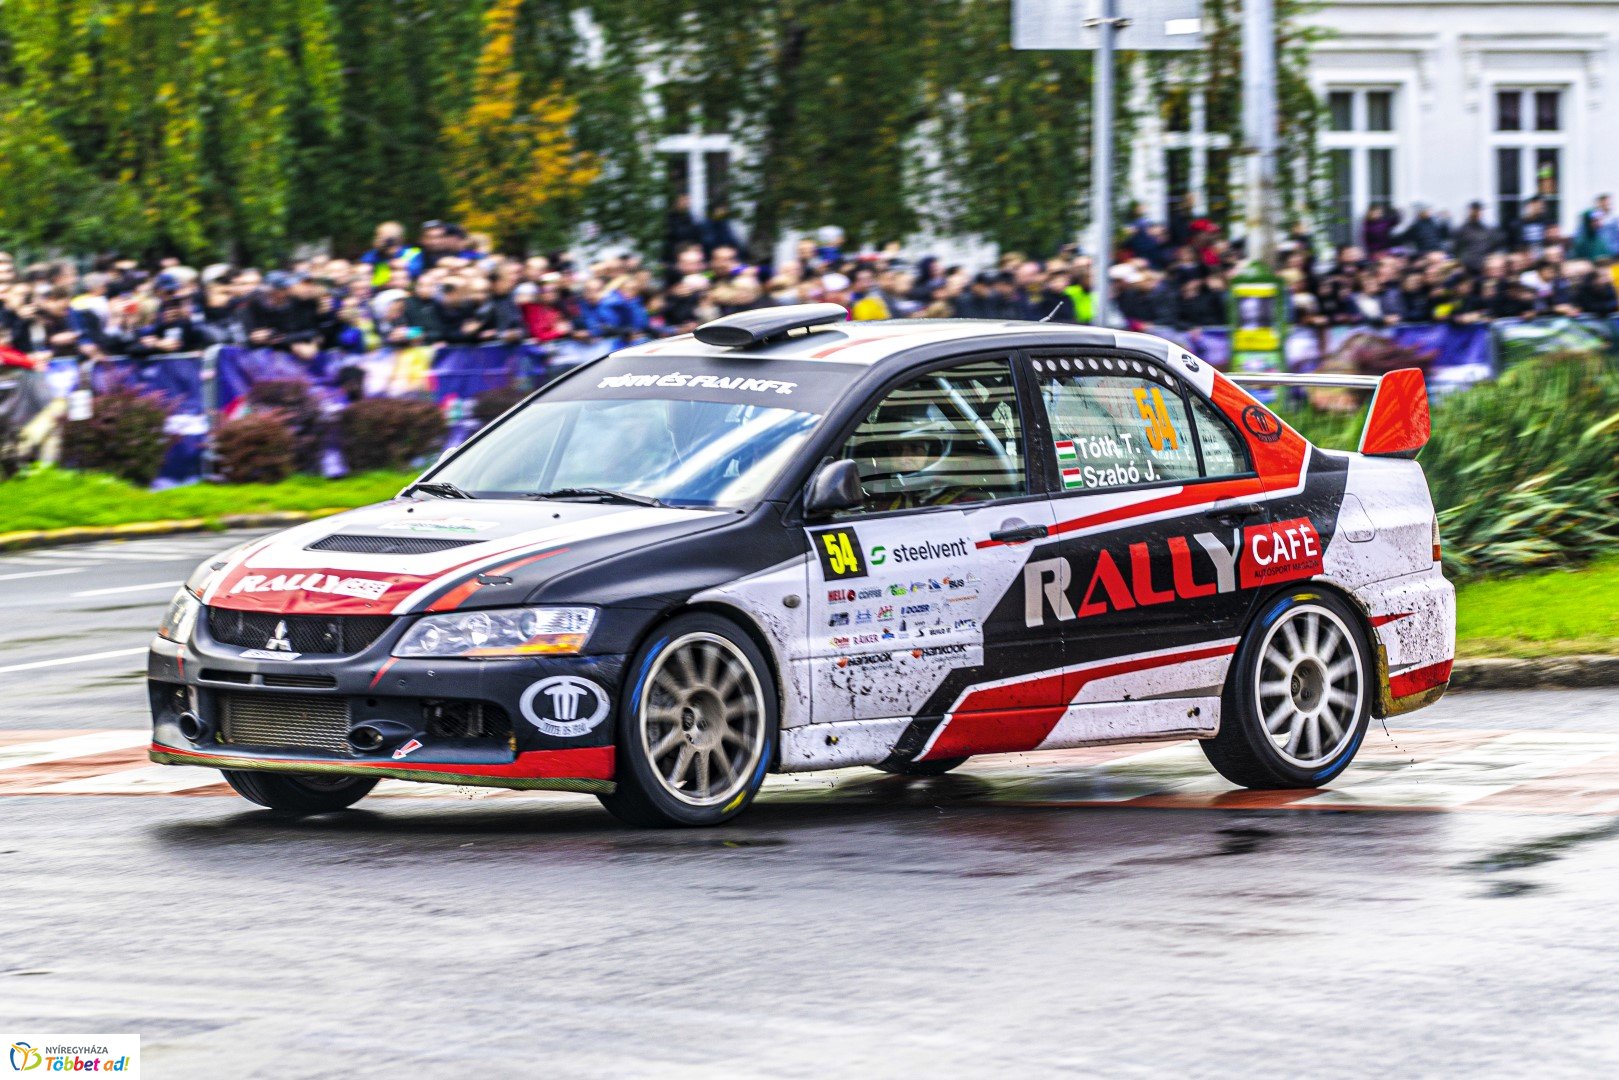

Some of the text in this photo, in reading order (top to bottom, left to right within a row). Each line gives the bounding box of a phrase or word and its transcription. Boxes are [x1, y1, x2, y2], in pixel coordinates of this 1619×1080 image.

[1132, 387, 1179, 451] 54
[1076, 436, 1124, 460] Tóth
[1119, 432, 1141, 454] T.
[1083, 459, 1161, 488] Szabó J.
[822, 532, 859, 575] 54
[893, 537, 968, 563] steelvent
[229, 573, 342, 594] RALLY
[1024, 528, 1241, 628] RALLY
[1254, 565, 1292, 578] AUTOSPORT
